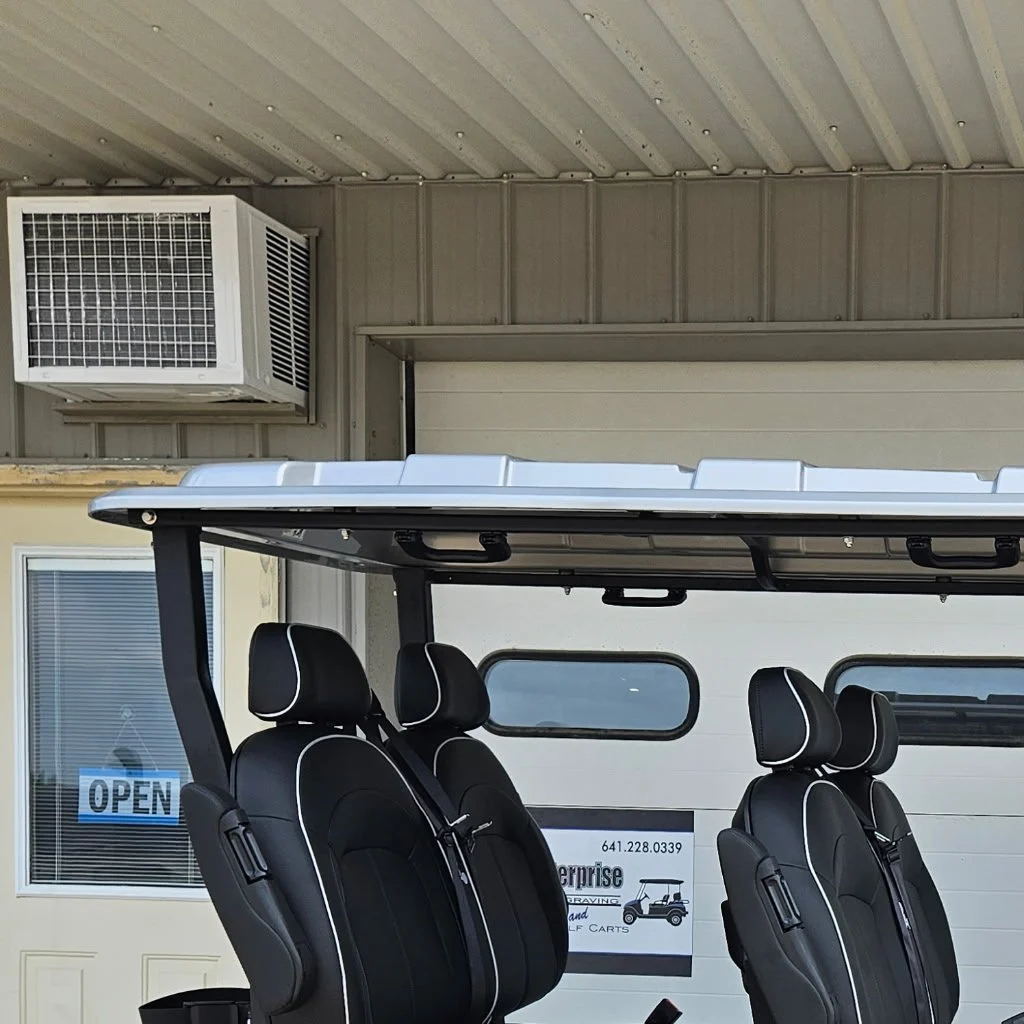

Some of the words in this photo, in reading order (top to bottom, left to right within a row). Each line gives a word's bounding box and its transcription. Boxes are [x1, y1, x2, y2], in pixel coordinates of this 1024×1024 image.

[88, 779, 172, 815] OPEN
[601, 840, 682, 854] 641.228.0339
[557, 862, 624, 890] erprise
